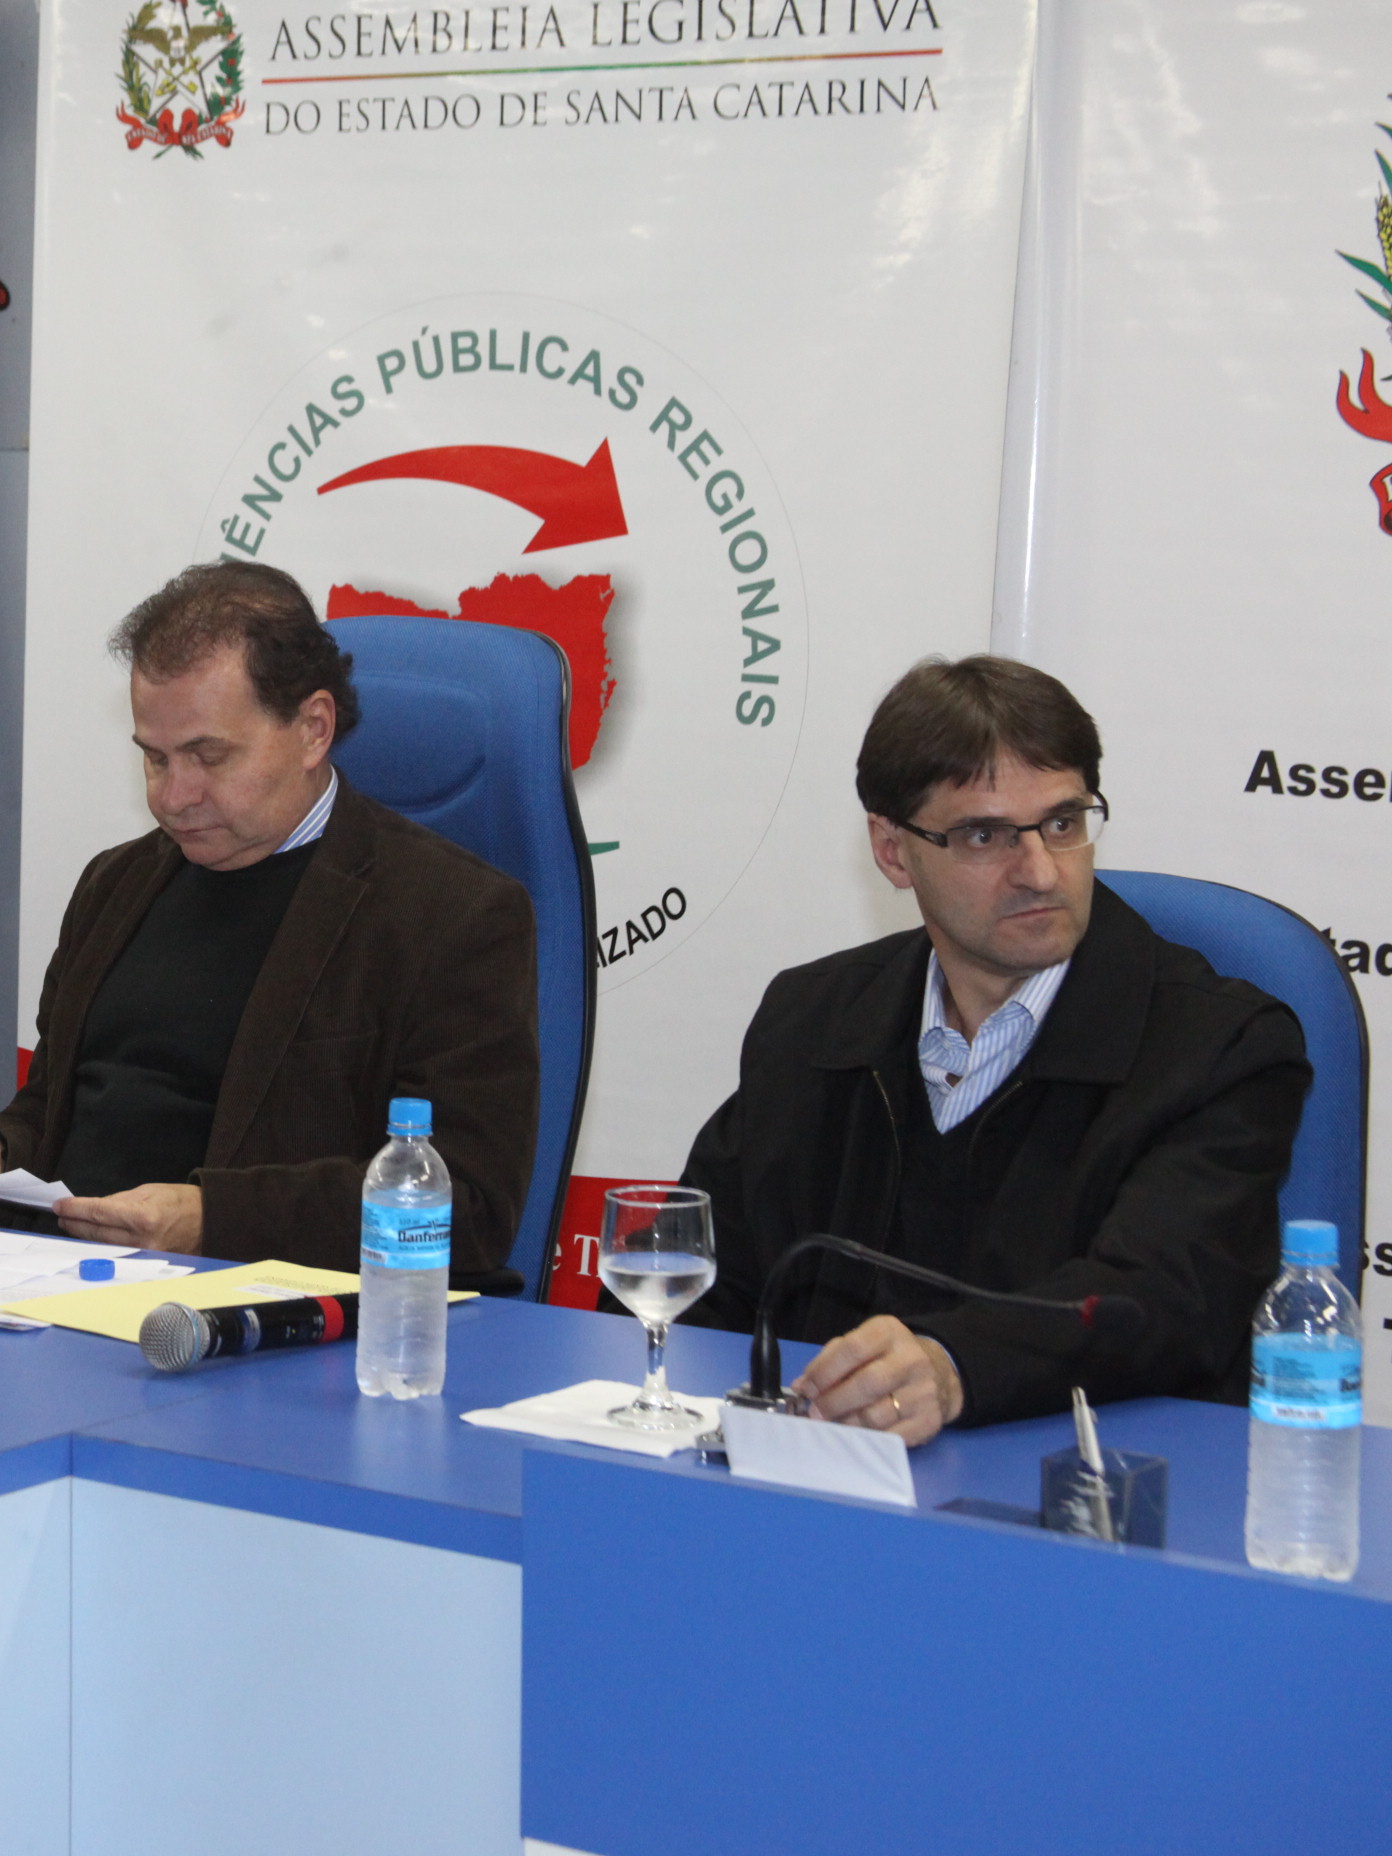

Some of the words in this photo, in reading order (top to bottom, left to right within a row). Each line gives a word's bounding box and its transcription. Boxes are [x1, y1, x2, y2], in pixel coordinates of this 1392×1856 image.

[269, 4, 566, 61] ASSEMBLEIA
[264, 100, 321, 136] DO
[337, 95, 481, 133] ESTADO
[499, 91, 548, 127] DE
[564, 86, 699, 127] SANTA
[713, 76, 940, 121] CATARINA
[219, 374, 365, 561] ÊNCIAS
[375, 326, 646, 412] PÚBLICAS
[648, 396, 782, 728] REGIONAIS
[1243, 749, 1392, 803] Asse
[596, 887, 687, 968] IZADO
